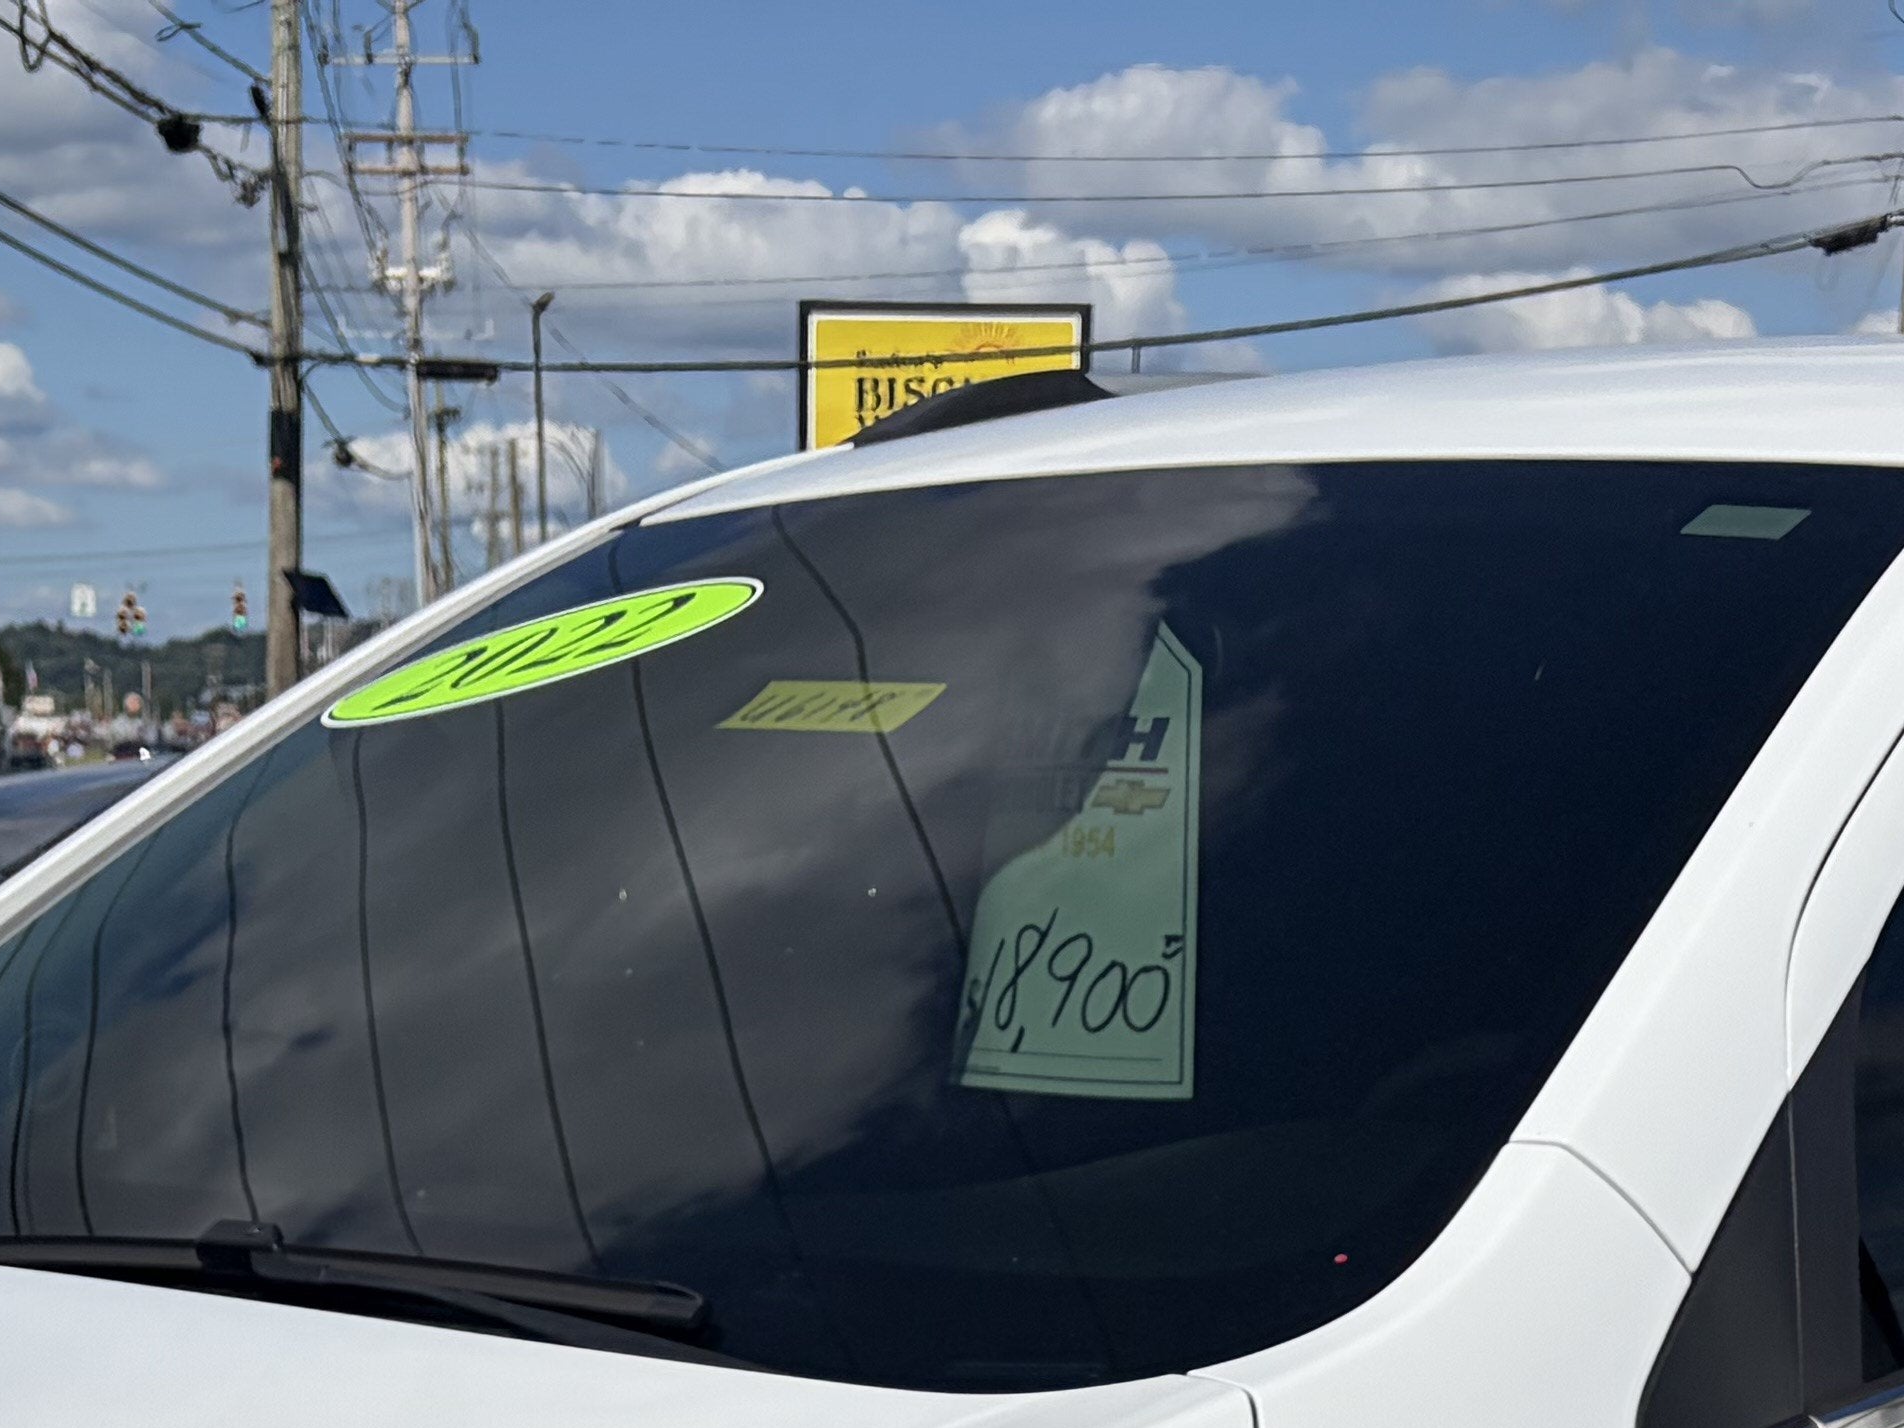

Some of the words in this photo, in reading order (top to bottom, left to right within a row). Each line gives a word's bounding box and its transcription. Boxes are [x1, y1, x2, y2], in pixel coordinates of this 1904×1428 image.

[856, 376, 973, 413] BISC
[371, 592, 698, 711] 2022
[1061, 826, 1117, 858] 1954
